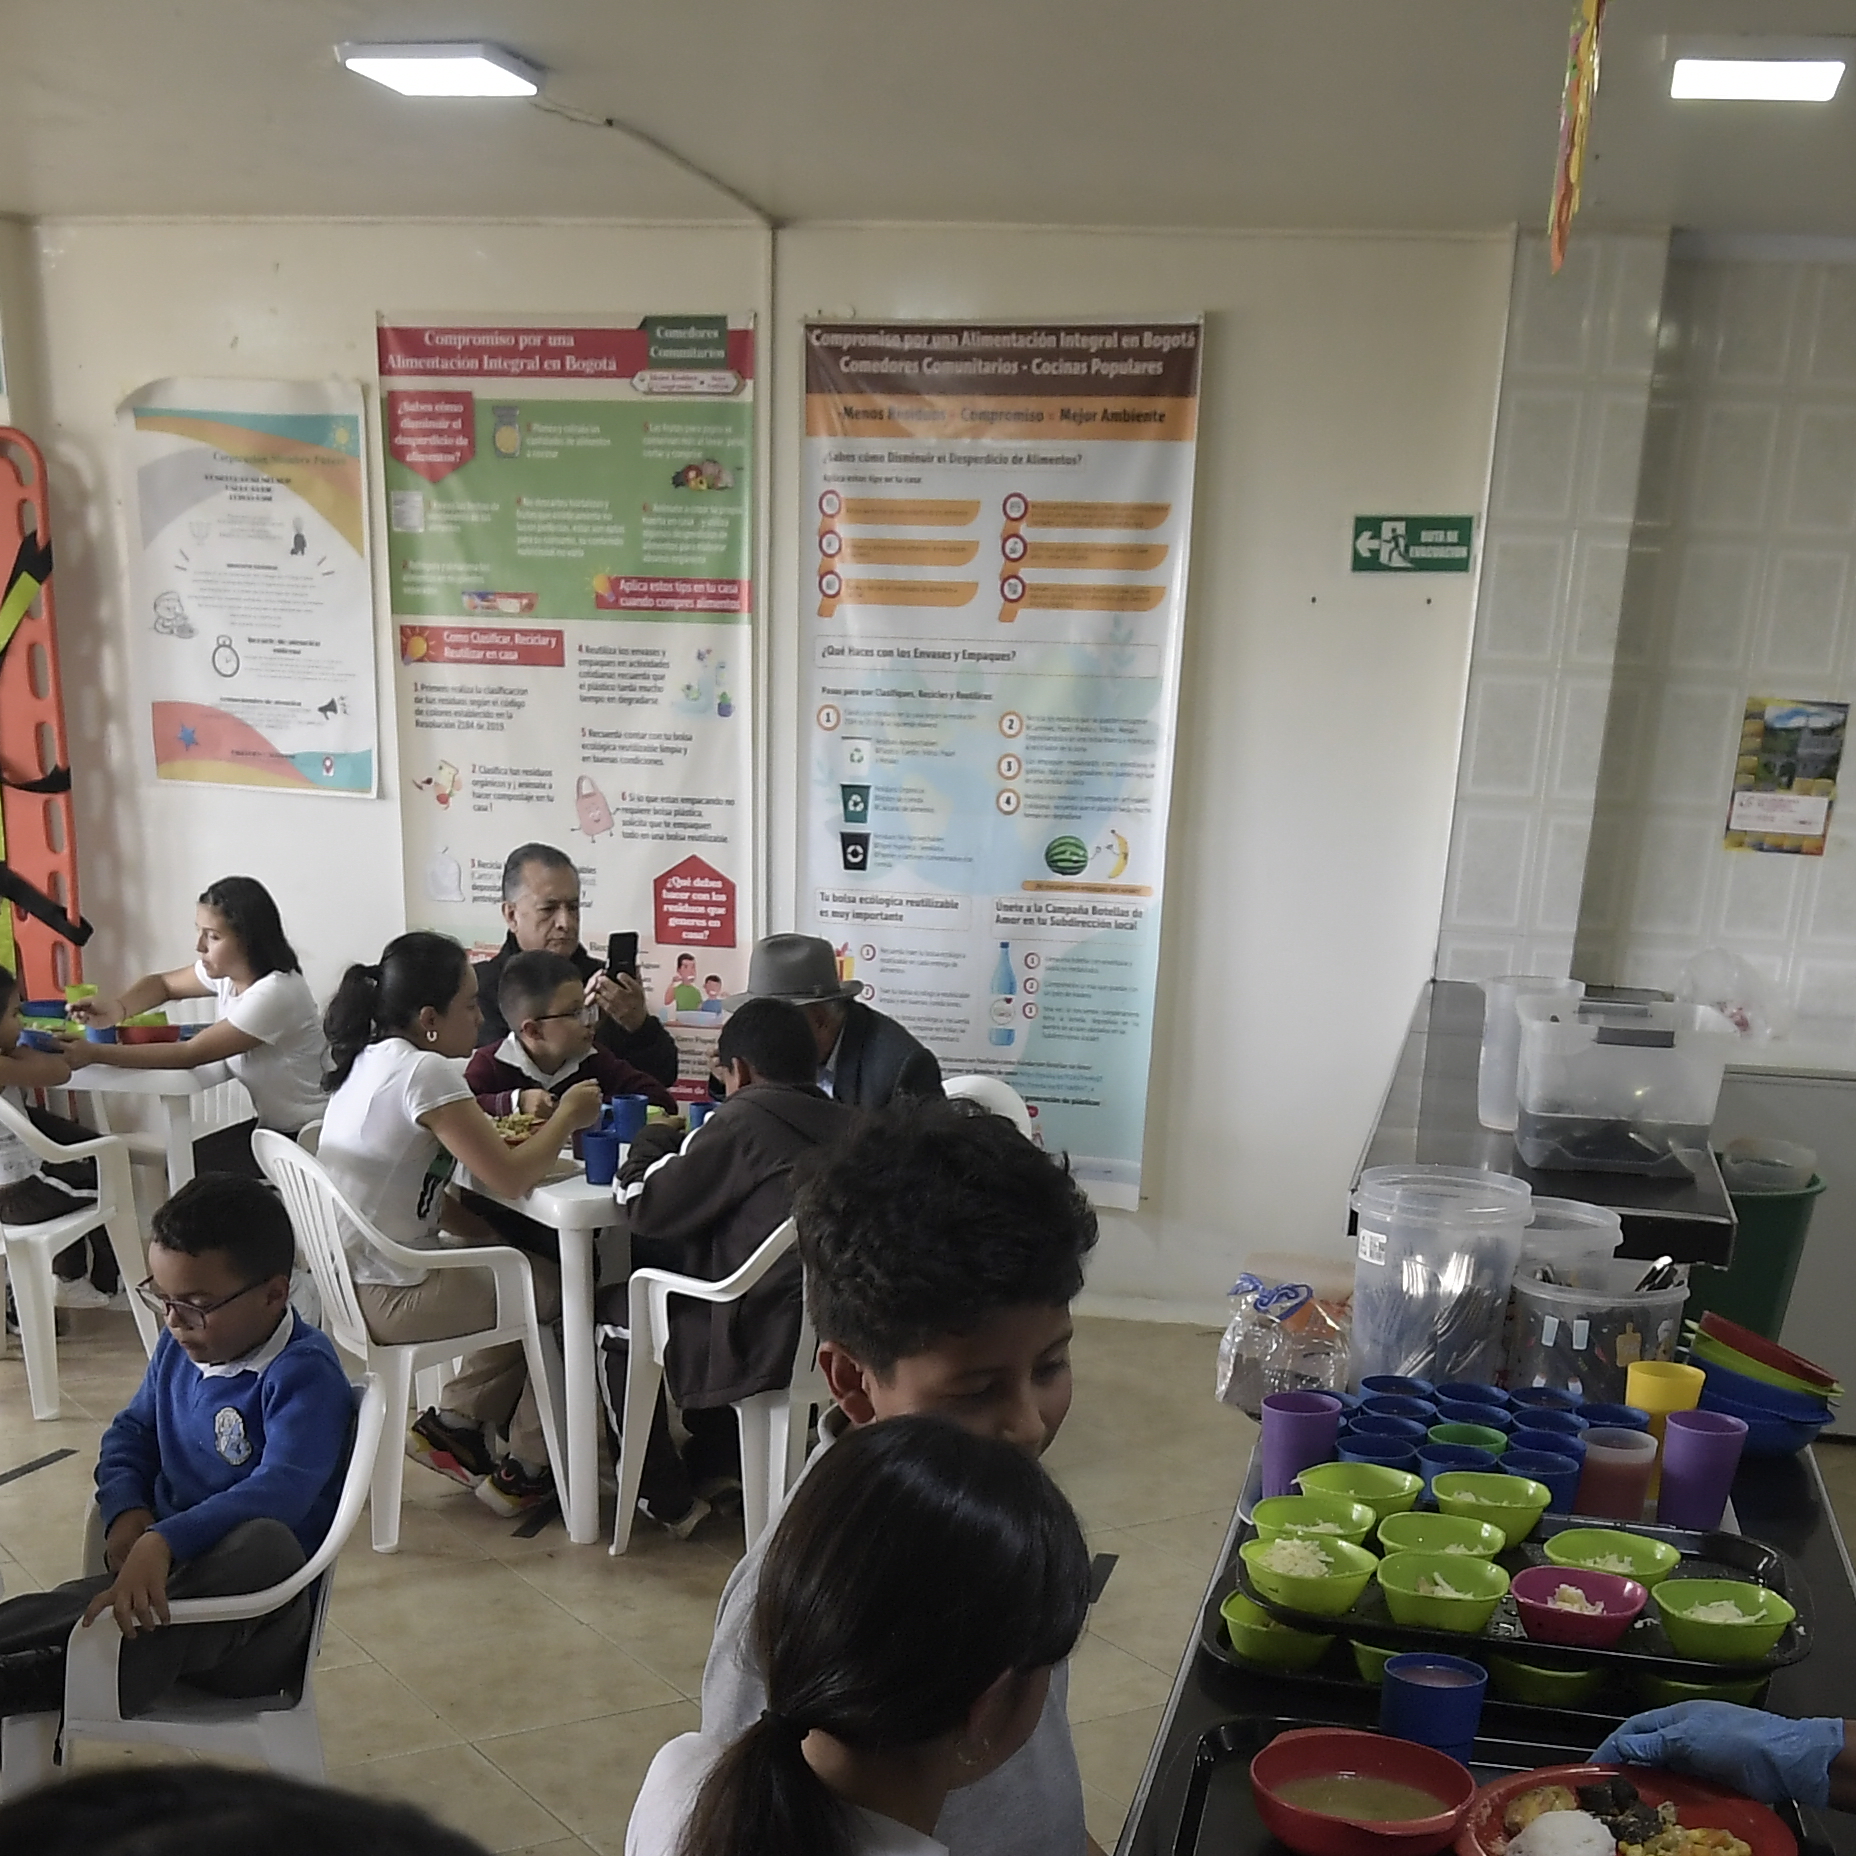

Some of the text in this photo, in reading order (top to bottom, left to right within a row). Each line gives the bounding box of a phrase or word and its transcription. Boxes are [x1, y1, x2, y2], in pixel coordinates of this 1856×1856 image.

[656, 327, 719, 338] Comedores
[424, 331, 575, 351] Compromiso por una
[811, 330, 1195, 353] Compromiso por una Alimentación Integral en Bogotá
[650, 346, 725, 358] Comunitarios
[386, 354, 617, 374] Alimentación Integral en Bogotá
[839, 356, 919, 374] Comedores
[922, 356, 1018, 374] Comunitarios
[1031, 358, 1088, 375] Cocinas
[1091, 358, 1163, 378] Populares
[843, 406, 884, 420] Menos
[961, 407, 1044, 424] Compromiso
[1059, 408, 1097, 426] Mejor
[1101, 408, 1166, 423] Ambiente
[400, 417, 461, 429] disminuir el
[395, 434, 469, 449] desperdicio de
[405, 451, 461, 463] alimentos?
[888, 451, 935, 463] Disminuir
[937, 454, 945, 463] el
[949, 452, 1009, 466] Desperdicio
[1011, 454, 1024, 465] de
[1026, 454, 1082, 465] Alimentos?
[1420, 530, 1459, 543] RUTA DE
[620, 579, 738, 594] Aplica estos tips en tu casa
[620, 597, 741, 610] cuando compres alimentos
[444, 631, 469, 642] Como
[471, 632, 513, 645] Clasificar,
[515, 633, 550, 645] Reciclar
[444, 647, 518, 660] Reutilizar en casa
[585, 645, 616, 655] Reutiliza
[821, 645, 844, 658] ¿Qué
[848, 646, 874, 657] Haces
[877, 648, 894, 657] con
[897, 647, 911, 658] los
[913, 648, 951, 659] Envases
[962, 649, 1017, 663] Empaques?
[578, 659, 670, 669] empaques actividades
[618, 671, 665, 682] recuerda que
[420, 683, 474, 694] Primero realiza
[639, 685, 664, 693] mucho
[579, 695, 605, 705] tiempo
[426, 709, 451, 717] colores
[588, 729, 693, 741] Recuerda bolsa
[593, 755, 618, 764] buenas
[478, 766, 553, 777] Clasifica residuos
[493, 792, 534, 803] compostaje
[681, 797, 723, 806] empacando
[622, 807, 672, 816] requiere bolsa
[673, 821, 712, 831] empaquen
[622, 830, 686, 841] todo bolsa
[667, 876, 722, 888] ¿Qué debes
[662, 889, 727, 902] hacer con los
[820, 892, 830, 901] Tu
[832, 893, 856, 904] bolsa
[906, 898, 959, 909] reutilizable
[663, 903, 726, 916] residuos que
[996, 900, 1024, 913] Únete
[1034, 904, 1043, 913] la
[1045, 904, 1089, 916] Campaña
[1092, 906, 1129, 917] Botellas
[1132, 908, 1143, 918] de
[832, 911, 849, 920] muy
[852, 910, 903, 921] importante
[668, 917, 706, 927] generes
[996, 915, 1137, 930] Amor en tu Subdirección local
[682, 931, 709, 940] casa?
